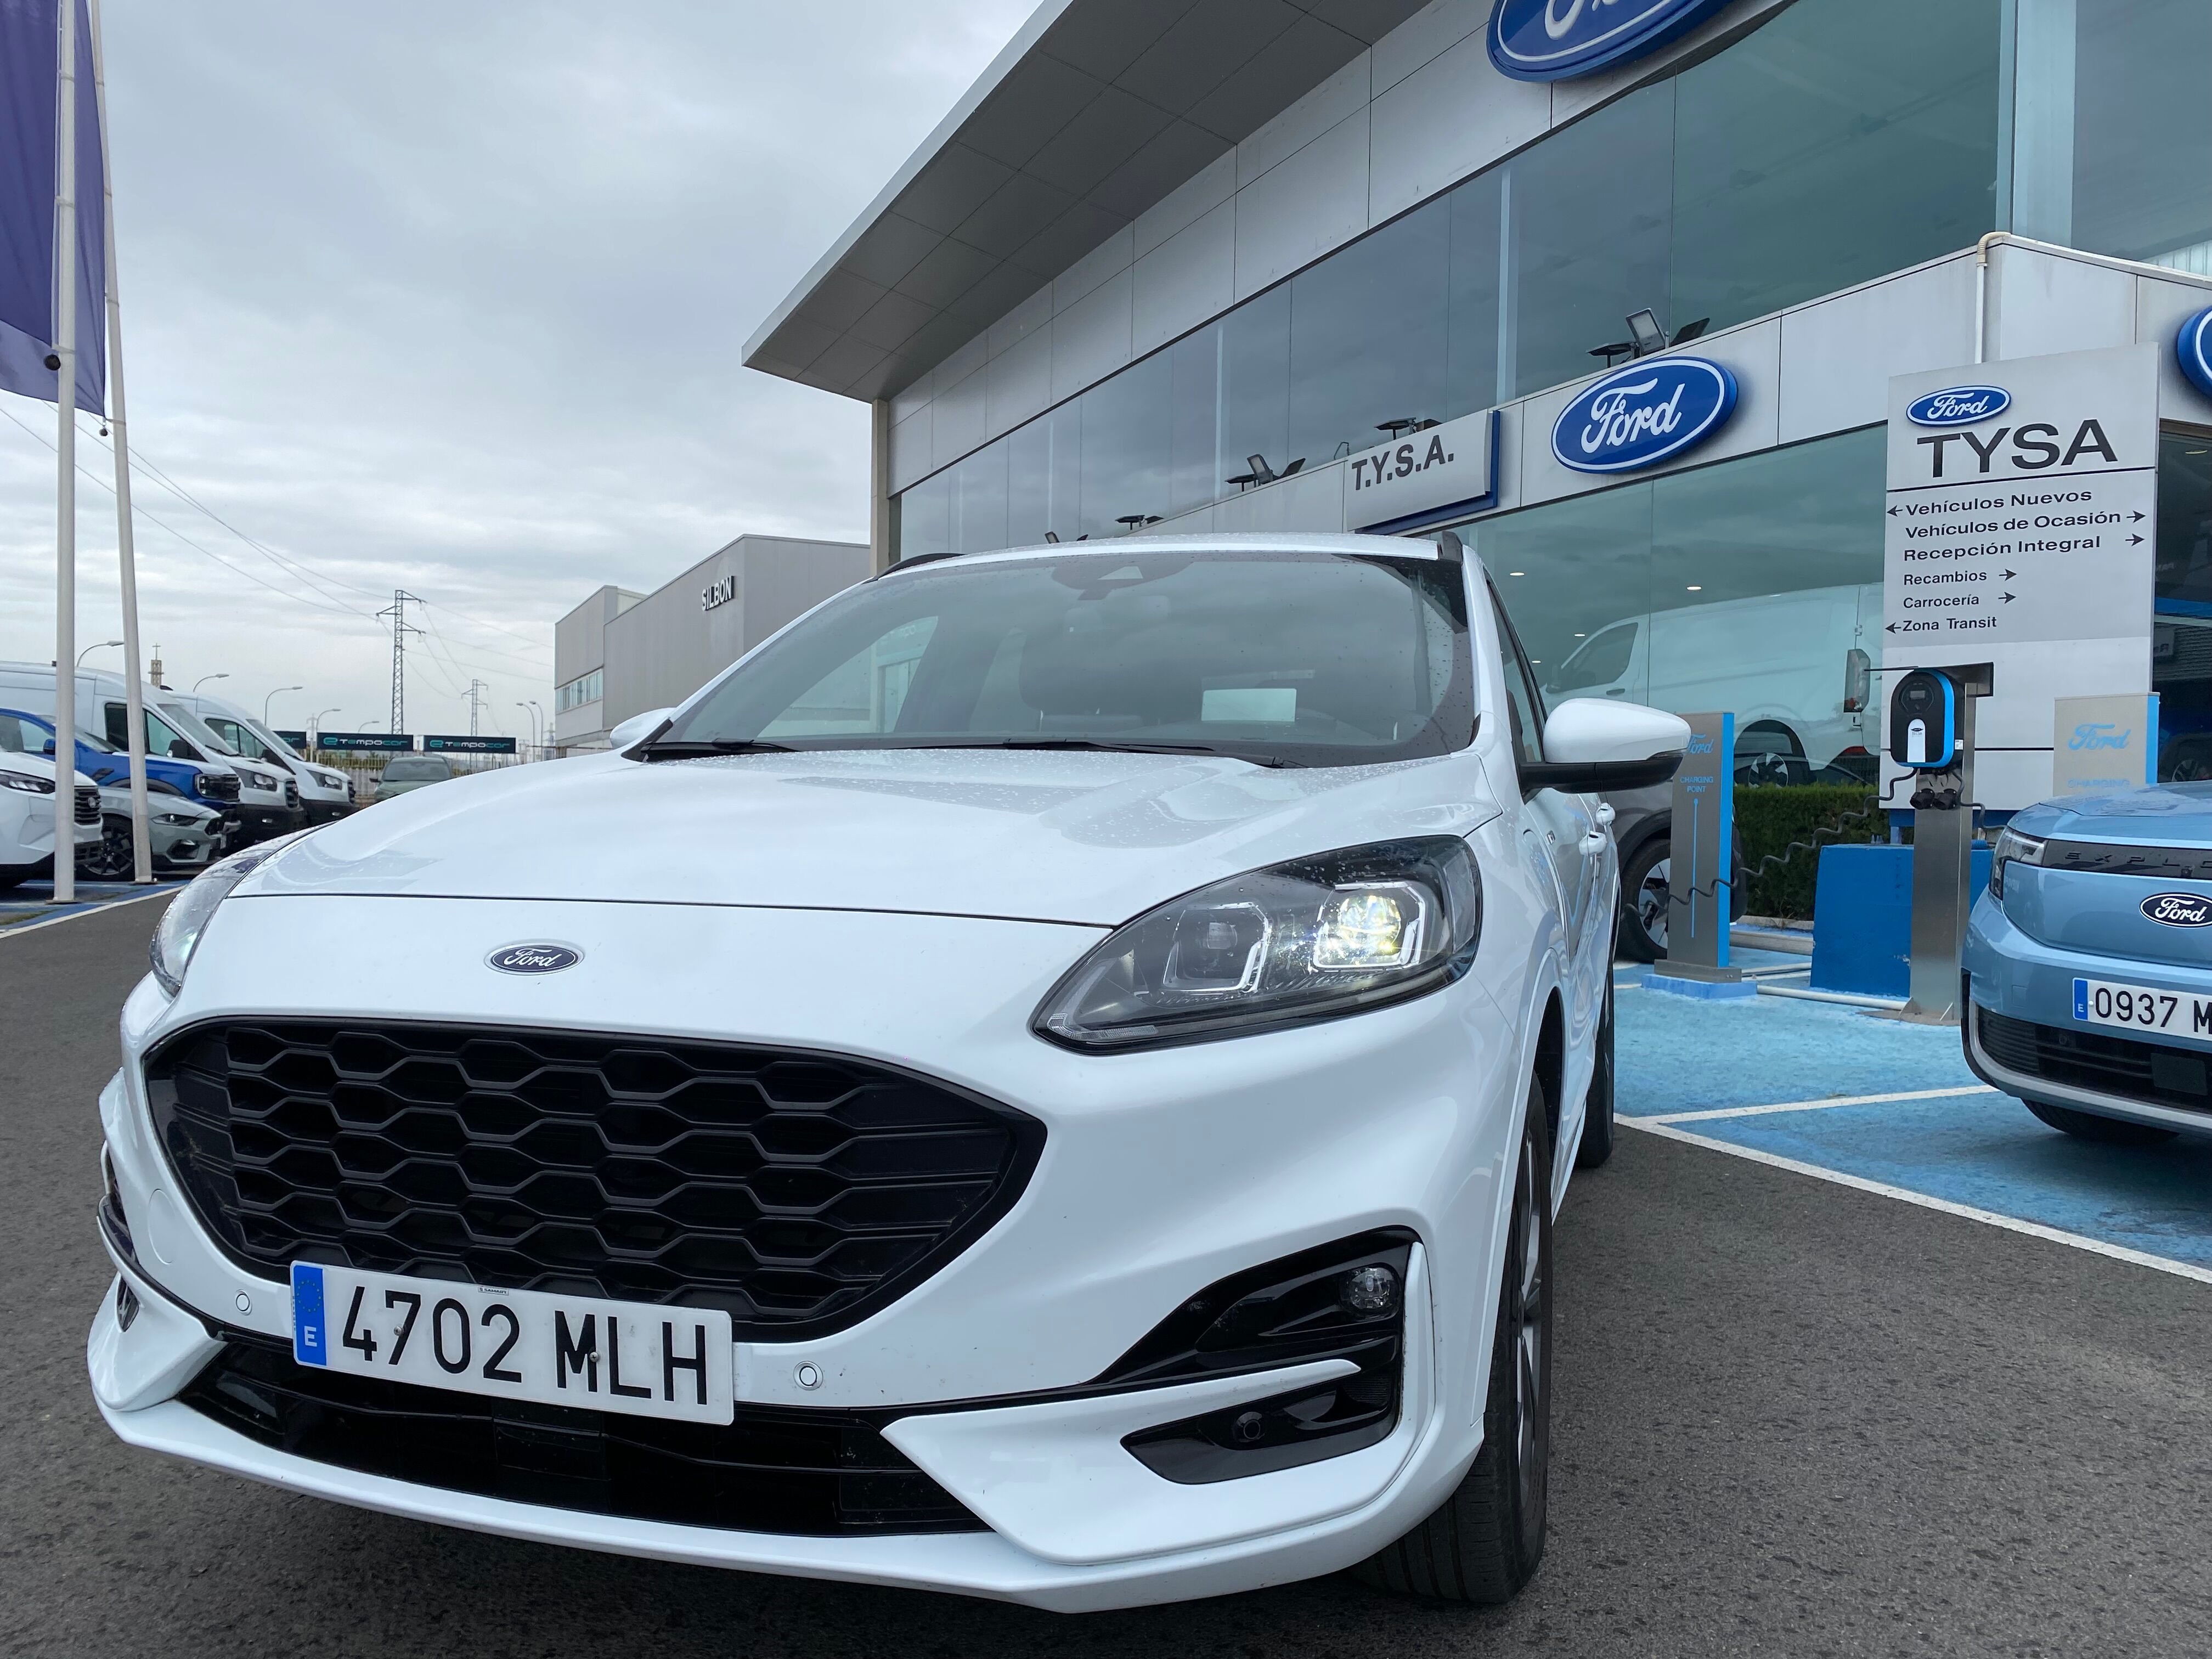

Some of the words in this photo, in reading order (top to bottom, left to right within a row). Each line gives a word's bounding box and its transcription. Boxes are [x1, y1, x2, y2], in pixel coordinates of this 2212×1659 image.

[1581, 377, 1685, 454] Ford
[1927, 392, 1988, 419] Ford
[1351, 434, 1454, 490] T.Y.S.A.
[1917, 419, 2118, 478] TYSA
[1905, 498, 2005, 516] Vehículos
[2011, 491, 2092, 506] Nuevos
[1905, 522, 1999, 538] Vehículos
[2004, 518, 2029, 531] de
[2034, 511, 2121, 528] Ocasión
[1904, 542, 2011, 561] Recepción
[2018, 535, 2100, 553] Integral
[1904, 570, 1987, 585] Recambios
[702, 575, 735, 611] SILBON
[1903, 594, 1979, 608] Carrocería
[1903, 620, 1939, 631] Zona
[1946, 616, 1997, 629] Transit
[2068, 723, 2131, 751] Ford
[2155, 897, 2207, 923] Ford
[504, 948, 562, 967] Ford
[2078, 1003, 2084, 1013] E
[2095, 987, 2178, 1028] 0937
[304, 1325, 318, 1347] E
[342, 1285, 522, 1384] 4702
[555, 1310, 708, 1406] MLH
